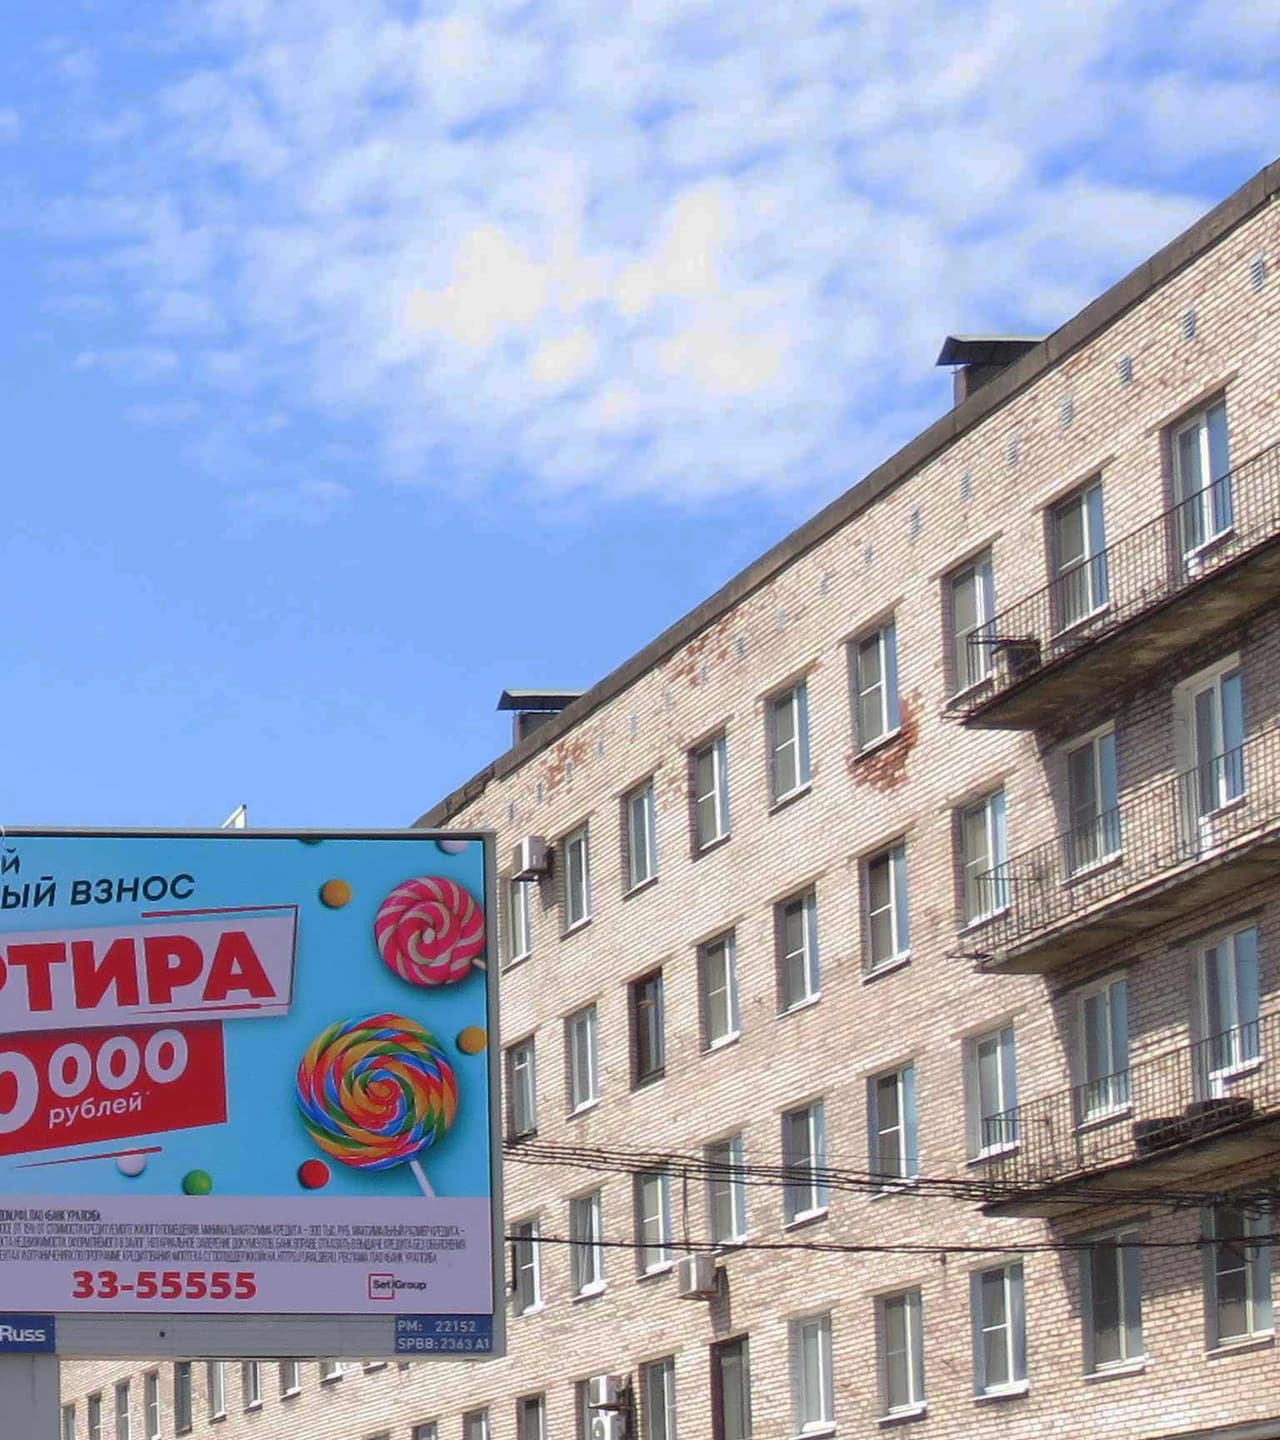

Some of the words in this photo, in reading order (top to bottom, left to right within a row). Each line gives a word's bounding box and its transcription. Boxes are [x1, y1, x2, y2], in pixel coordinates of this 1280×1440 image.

[70, 873, 195, 905] взнос
[72, 1270, 256, 1299] 33-55555
[435, 1320, 477, 1332] 22152
